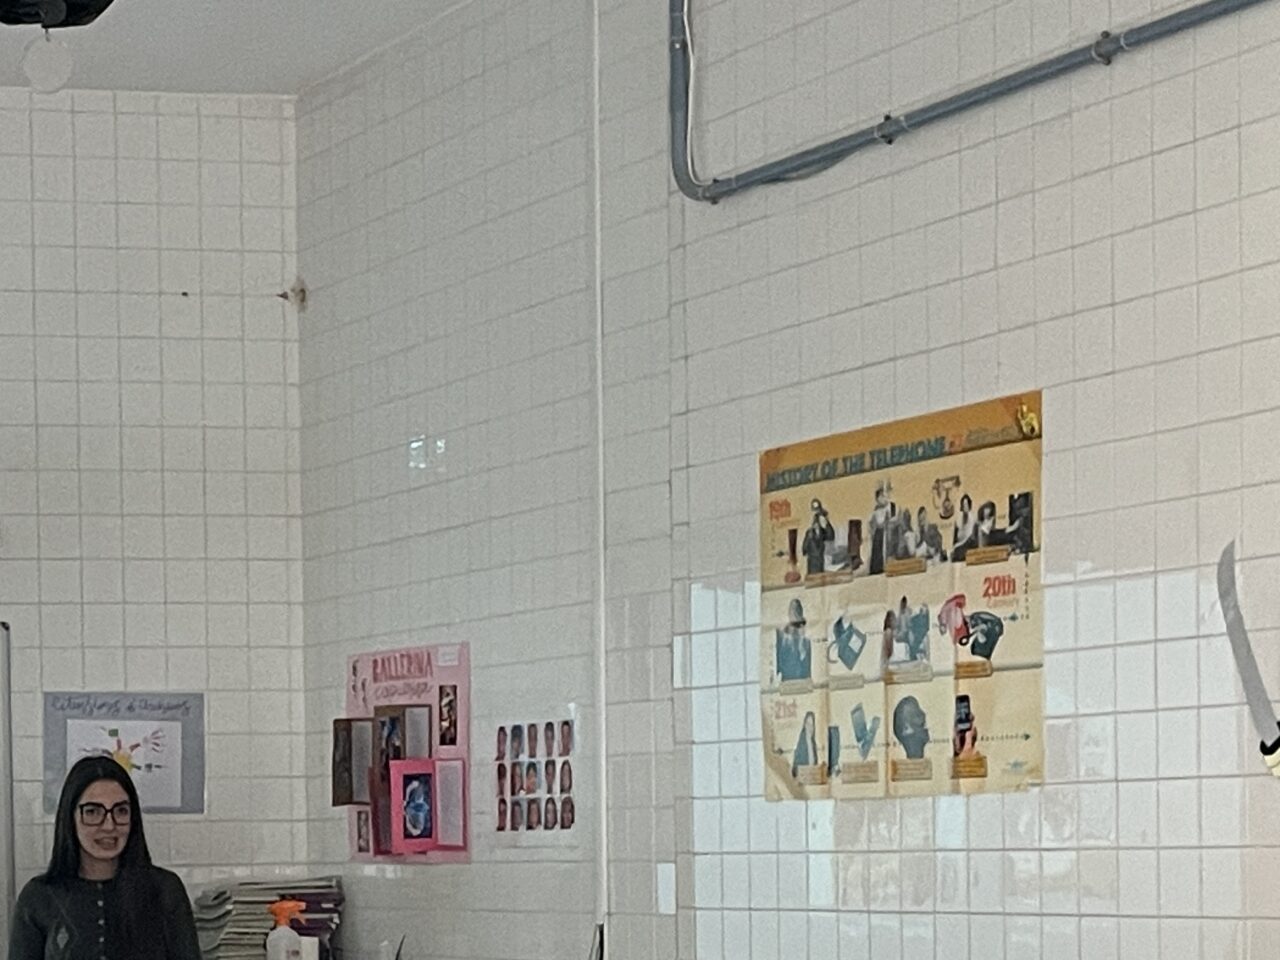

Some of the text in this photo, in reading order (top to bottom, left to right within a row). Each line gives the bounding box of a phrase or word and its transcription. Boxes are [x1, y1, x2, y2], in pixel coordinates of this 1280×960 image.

[843, 453, 866, 475] THE
[869, 436, 946, 470] TELEPHONE
[982, 574, 1016, 598] 20th
